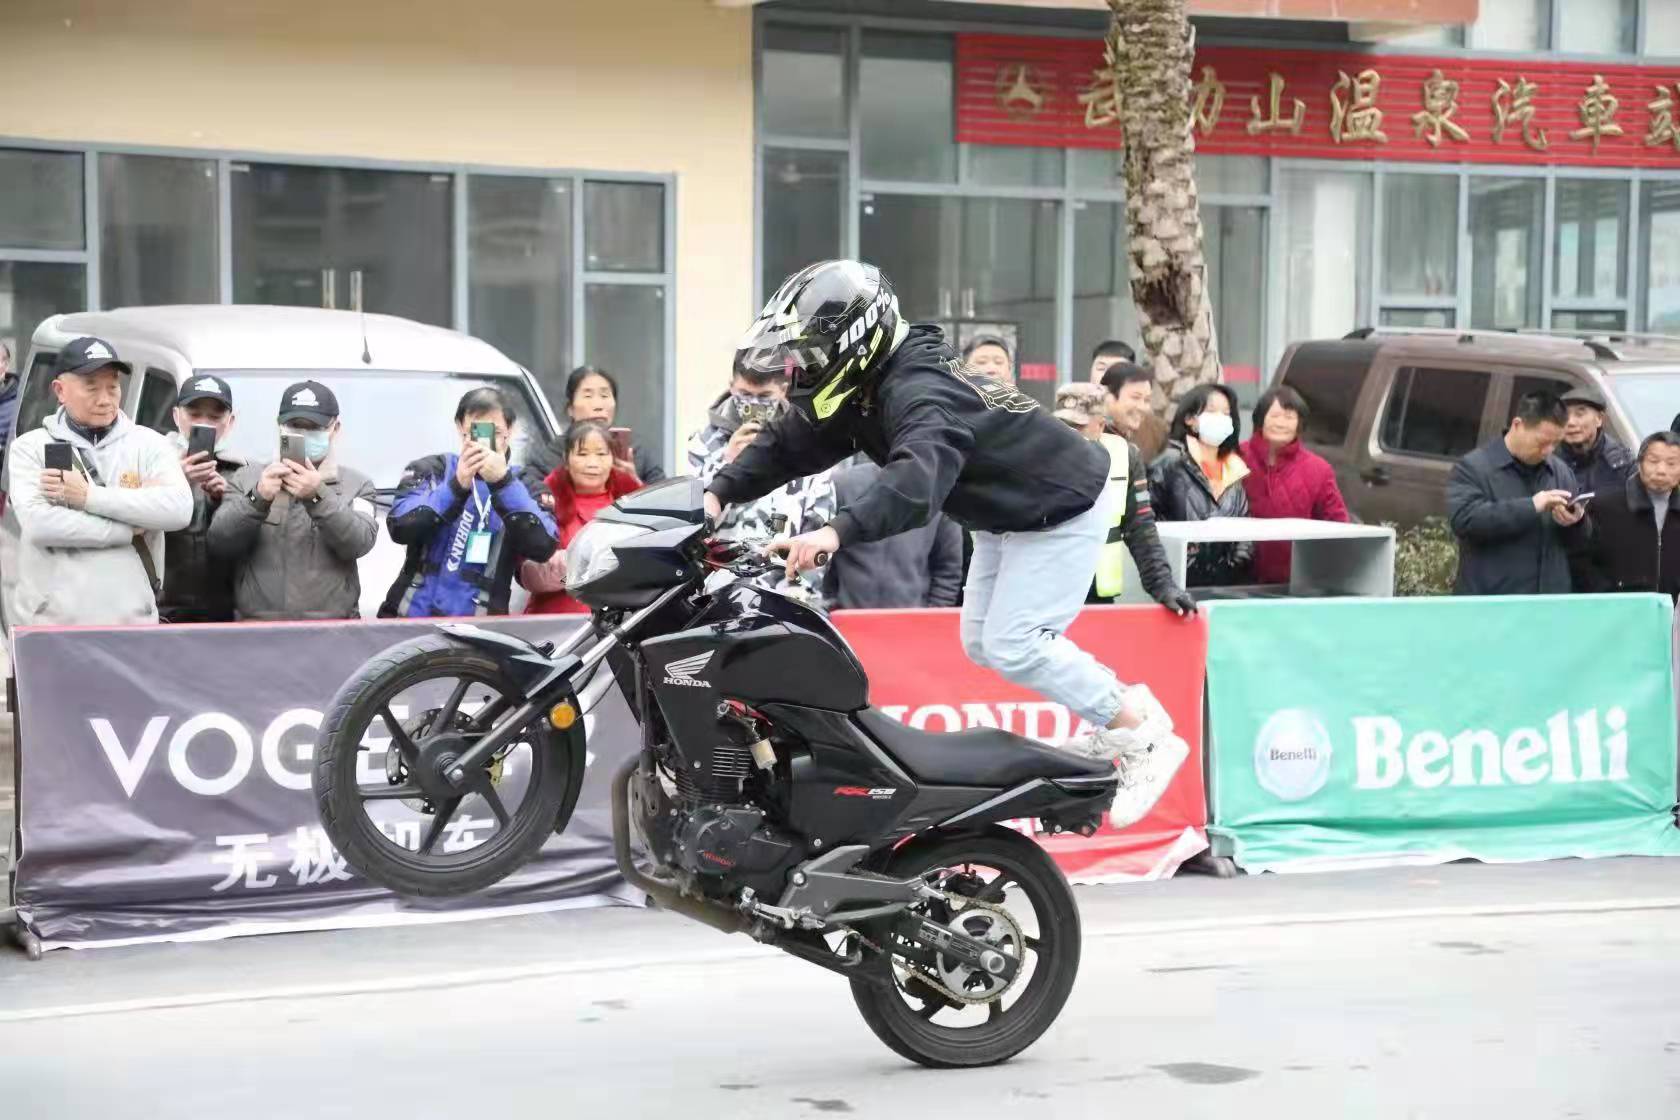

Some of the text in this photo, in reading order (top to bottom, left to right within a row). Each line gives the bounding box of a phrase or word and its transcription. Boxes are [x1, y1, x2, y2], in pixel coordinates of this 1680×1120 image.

[836, 286, 891, 355] 100%
[450, 509, 475, 563] DUHAN
[663, 676, 712, 688] HONDA
[878, 701, 1102, 750] OND
[1351, 705, 1630, 790] Benelli
[1269, 746, 1318, 761] Benelli
